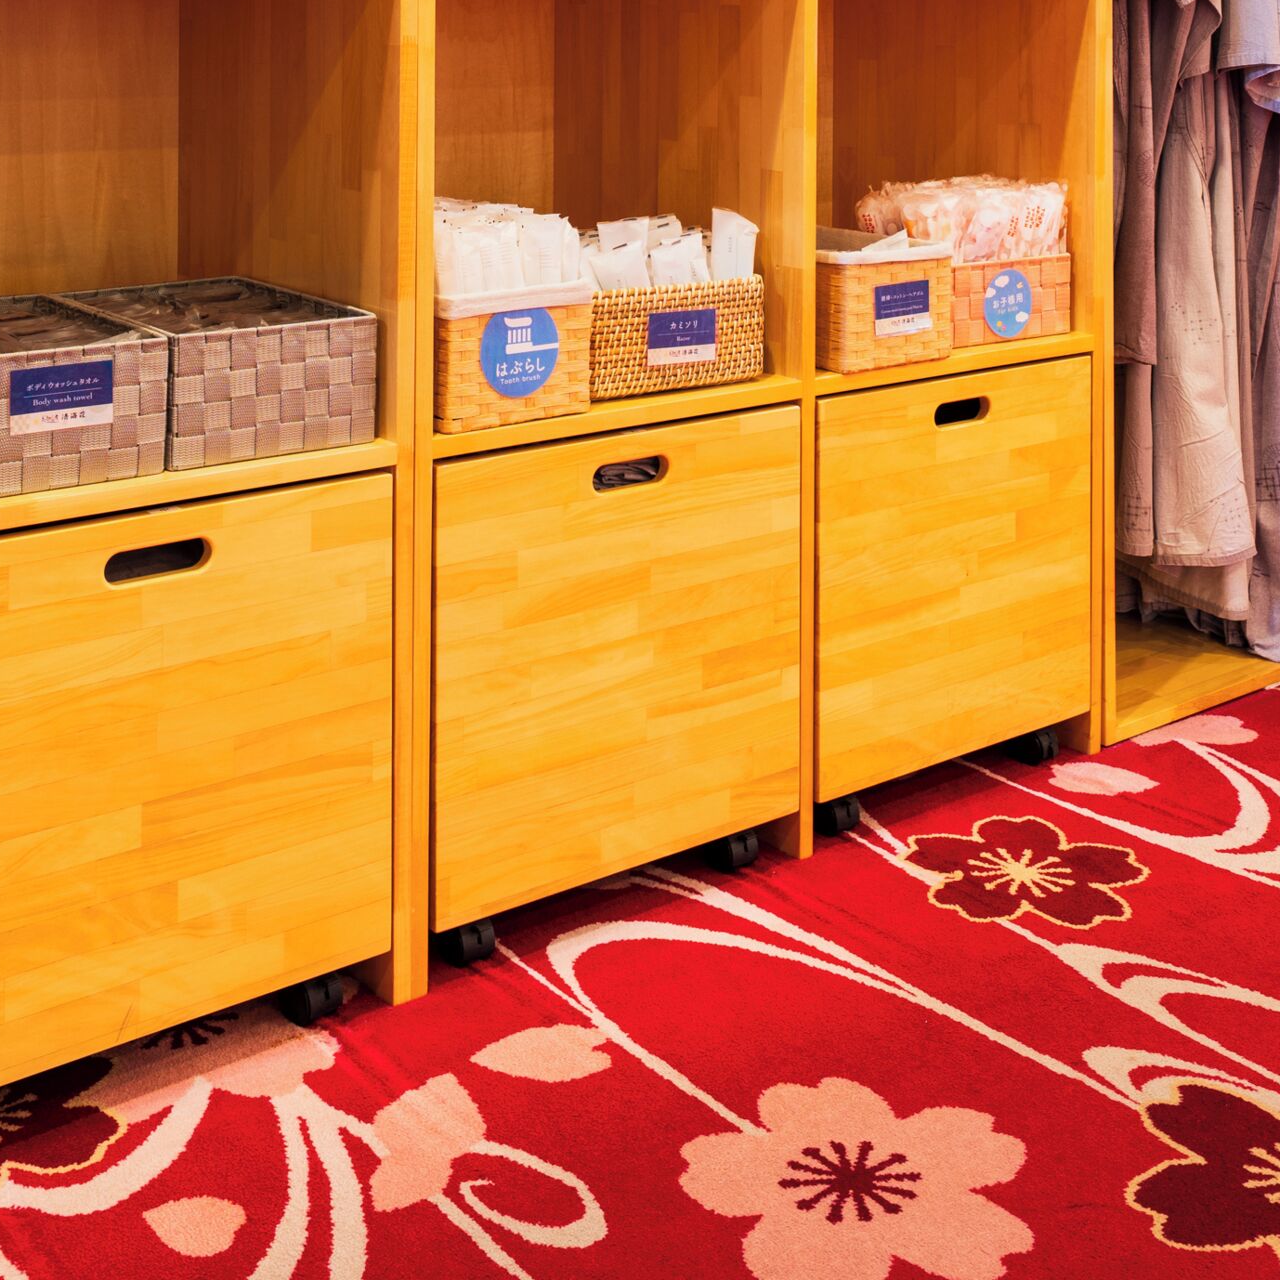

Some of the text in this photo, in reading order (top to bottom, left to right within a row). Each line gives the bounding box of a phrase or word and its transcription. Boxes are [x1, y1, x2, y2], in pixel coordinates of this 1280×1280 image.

[669, 320, 698, 330] カミソリ
[496, 357, 546, 378] はぶらし
[26, 377, 100, 392] ボディウォッシュタオル
[500, 374, 541, 385] Tooth brush
[32, 392, 94, 407] Body wash towel
